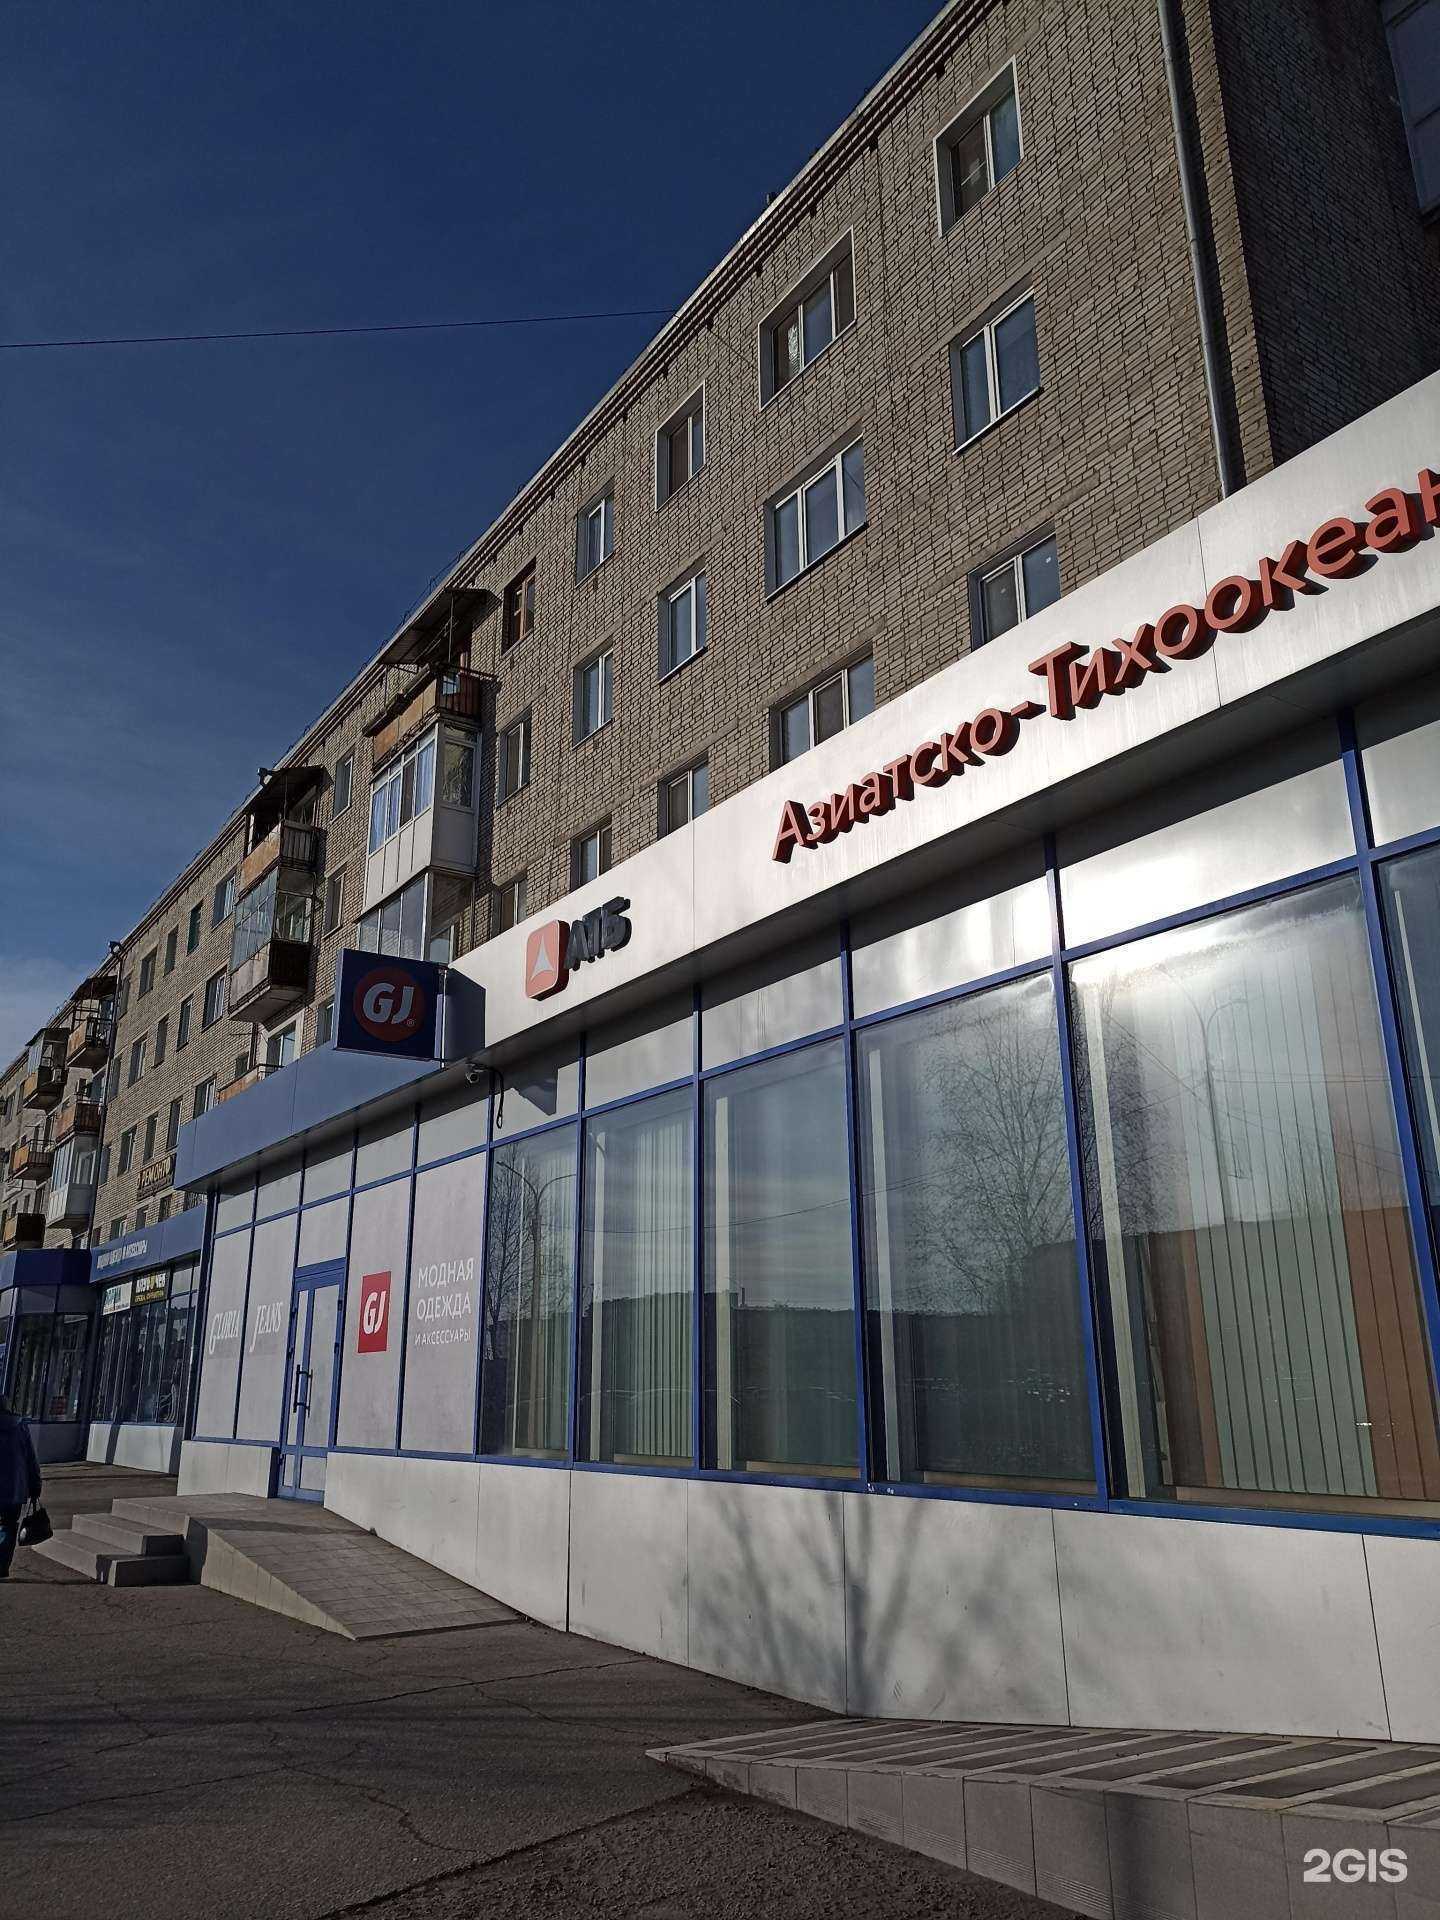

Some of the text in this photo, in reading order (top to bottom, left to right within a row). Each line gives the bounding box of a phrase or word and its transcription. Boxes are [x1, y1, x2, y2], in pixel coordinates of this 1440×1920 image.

[363, 983, 415, 1024] GJ
[417, 1257, 474, 1289] МОДНАЯ
[363, 1290, 386, 1335] GJ
[416, 1292, 471, 1320] ОДЕЖДА
[250, 1302, 283, 1352] JEANS
[414, 1327, 471, 1346] И АКСЕССУАРЫ
